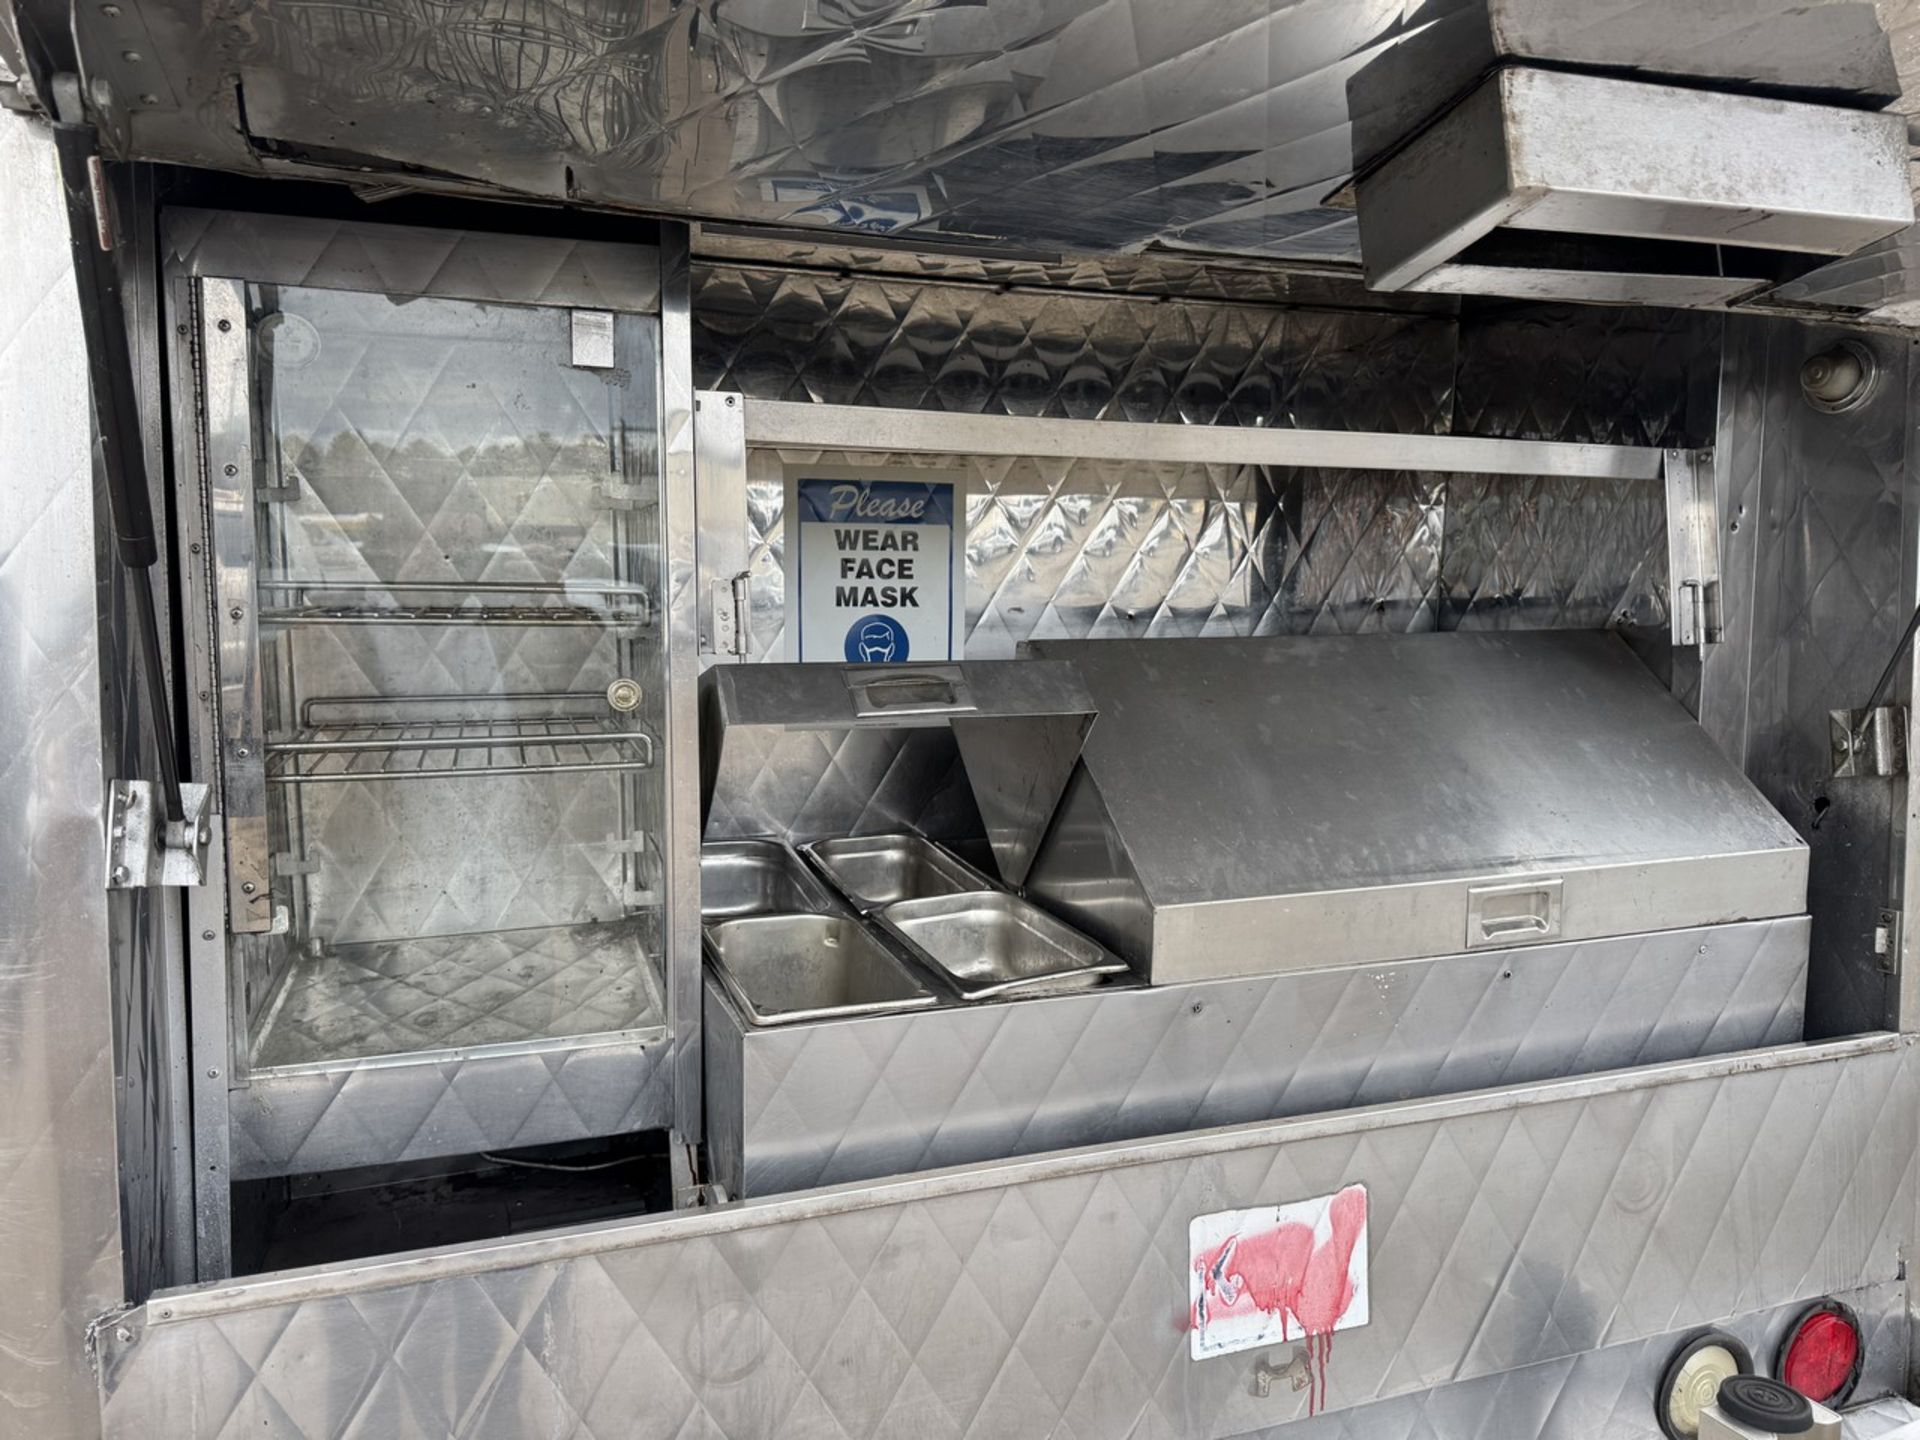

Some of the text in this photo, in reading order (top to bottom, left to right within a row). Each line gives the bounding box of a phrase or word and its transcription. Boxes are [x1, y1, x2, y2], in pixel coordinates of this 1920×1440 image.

[829, 485, 925, 519] Please
[834, 529, 919, 552] WEAR
[840, 558, 914, 580] FACE
[835, 586, 920, 608] MASK
